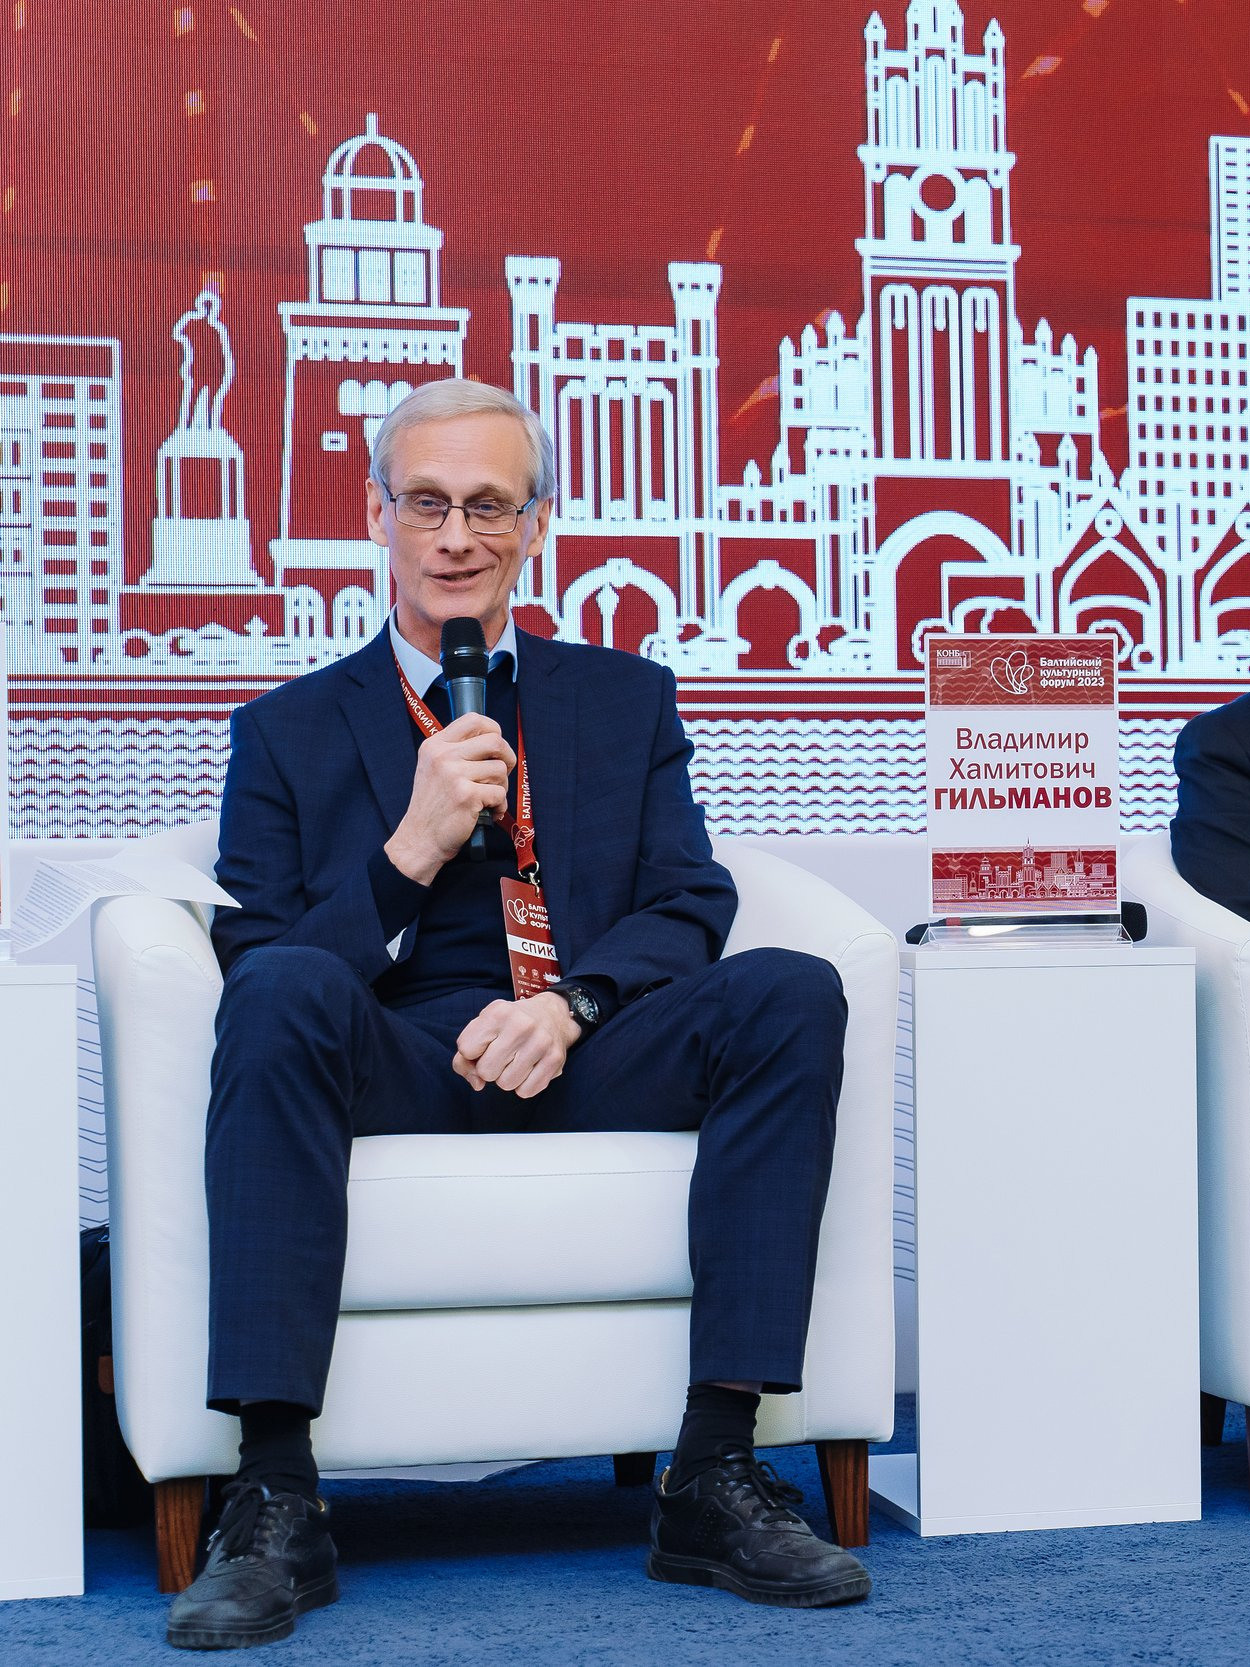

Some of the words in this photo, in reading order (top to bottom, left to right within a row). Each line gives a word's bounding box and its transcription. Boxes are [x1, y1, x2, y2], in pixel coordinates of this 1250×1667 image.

[936, 649, 960, 657] КОНБ
[1040, 657, 1102, 667] Балтийский
[1040, 668, 1101, 677] культурный
[1040, 678, 1075, 688] форум
[1077, 677, 1105, 687] 2023
[956, 727, 1089, 753] Владимир
[949, 757, 1095, 780] Хамитович
[934, 786, 1112, 810] ГИЛЬМАНОВ
[521, 941, 555, 958] СПИК
